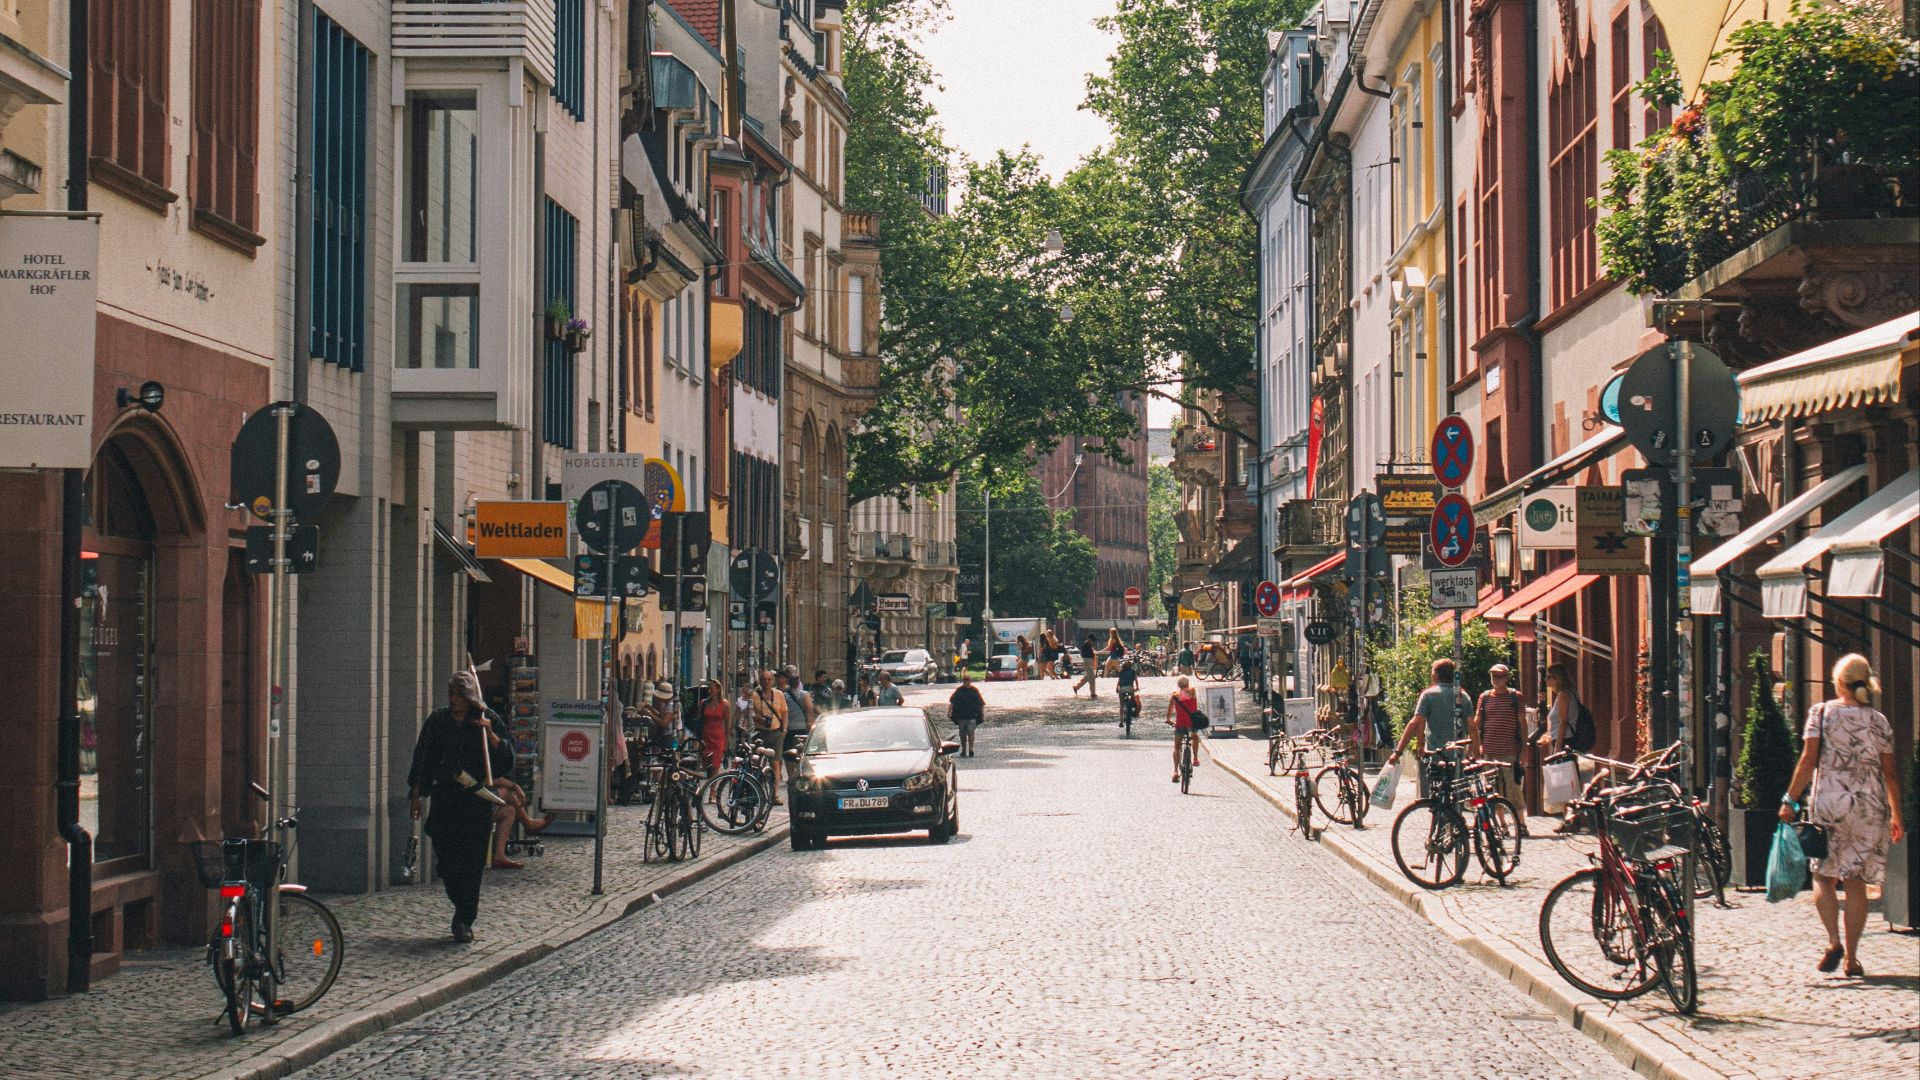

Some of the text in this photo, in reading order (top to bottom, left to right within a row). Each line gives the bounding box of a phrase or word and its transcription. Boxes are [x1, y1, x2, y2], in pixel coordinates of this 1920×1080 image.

[23, 254, 65, 265] HOTEL
[0, 268, 91, 280] MARKGRÄFLER
[30, 284, 57, 295] HOF
[1559, 504, 1574, 523] it
[480, 523, 563, 538] Weltladen
[1433, 575, 1474, 589] werktags
